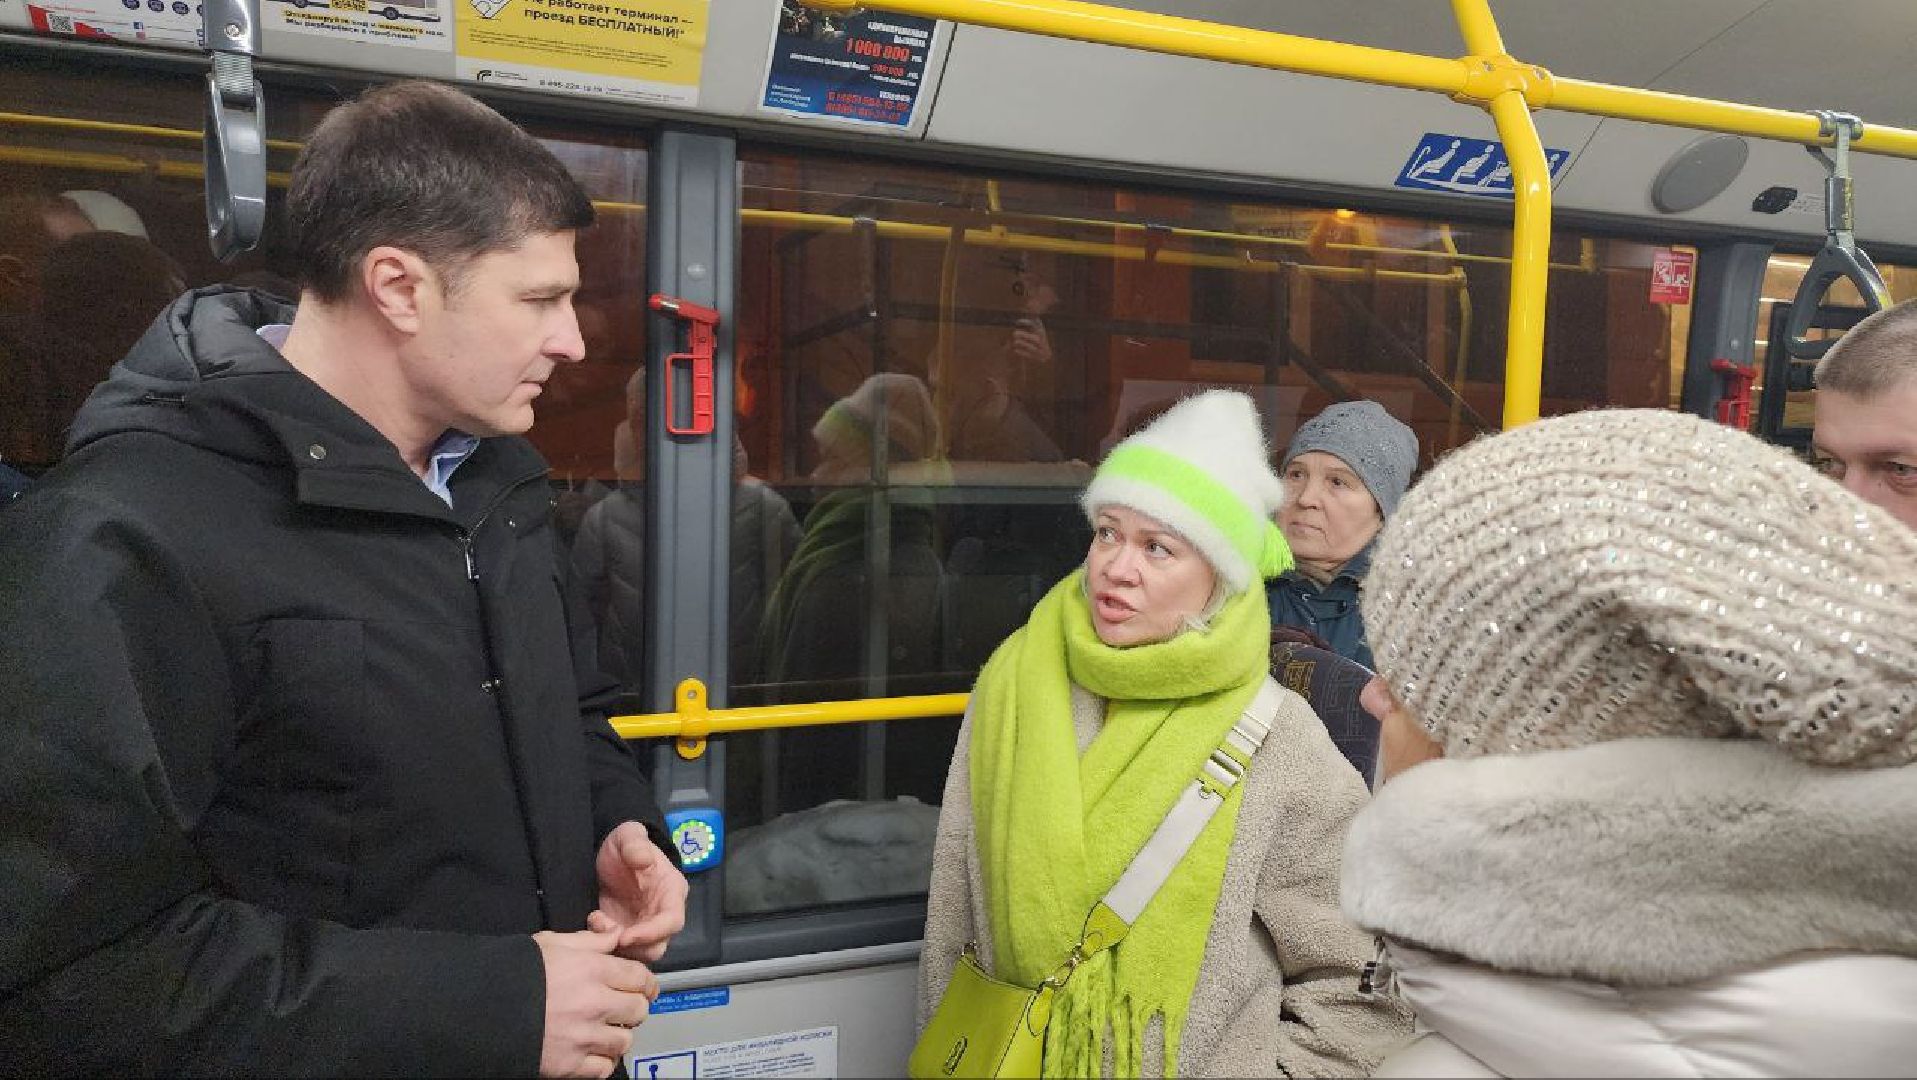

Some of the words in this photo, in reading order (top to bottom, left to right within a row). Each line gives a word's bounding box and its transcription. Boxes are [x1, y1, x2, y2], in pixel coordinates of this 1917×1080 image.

[524, 9, 575, 25] проезд
[548, 0, 610, 13] работает
[614, 8, 679, 23] терминал
[285, 18, 303, 26] Мы
[846, 37, 854, 53] 1
[854, 39, 881, 57] 000
[884, 45, 910, 62] 000
